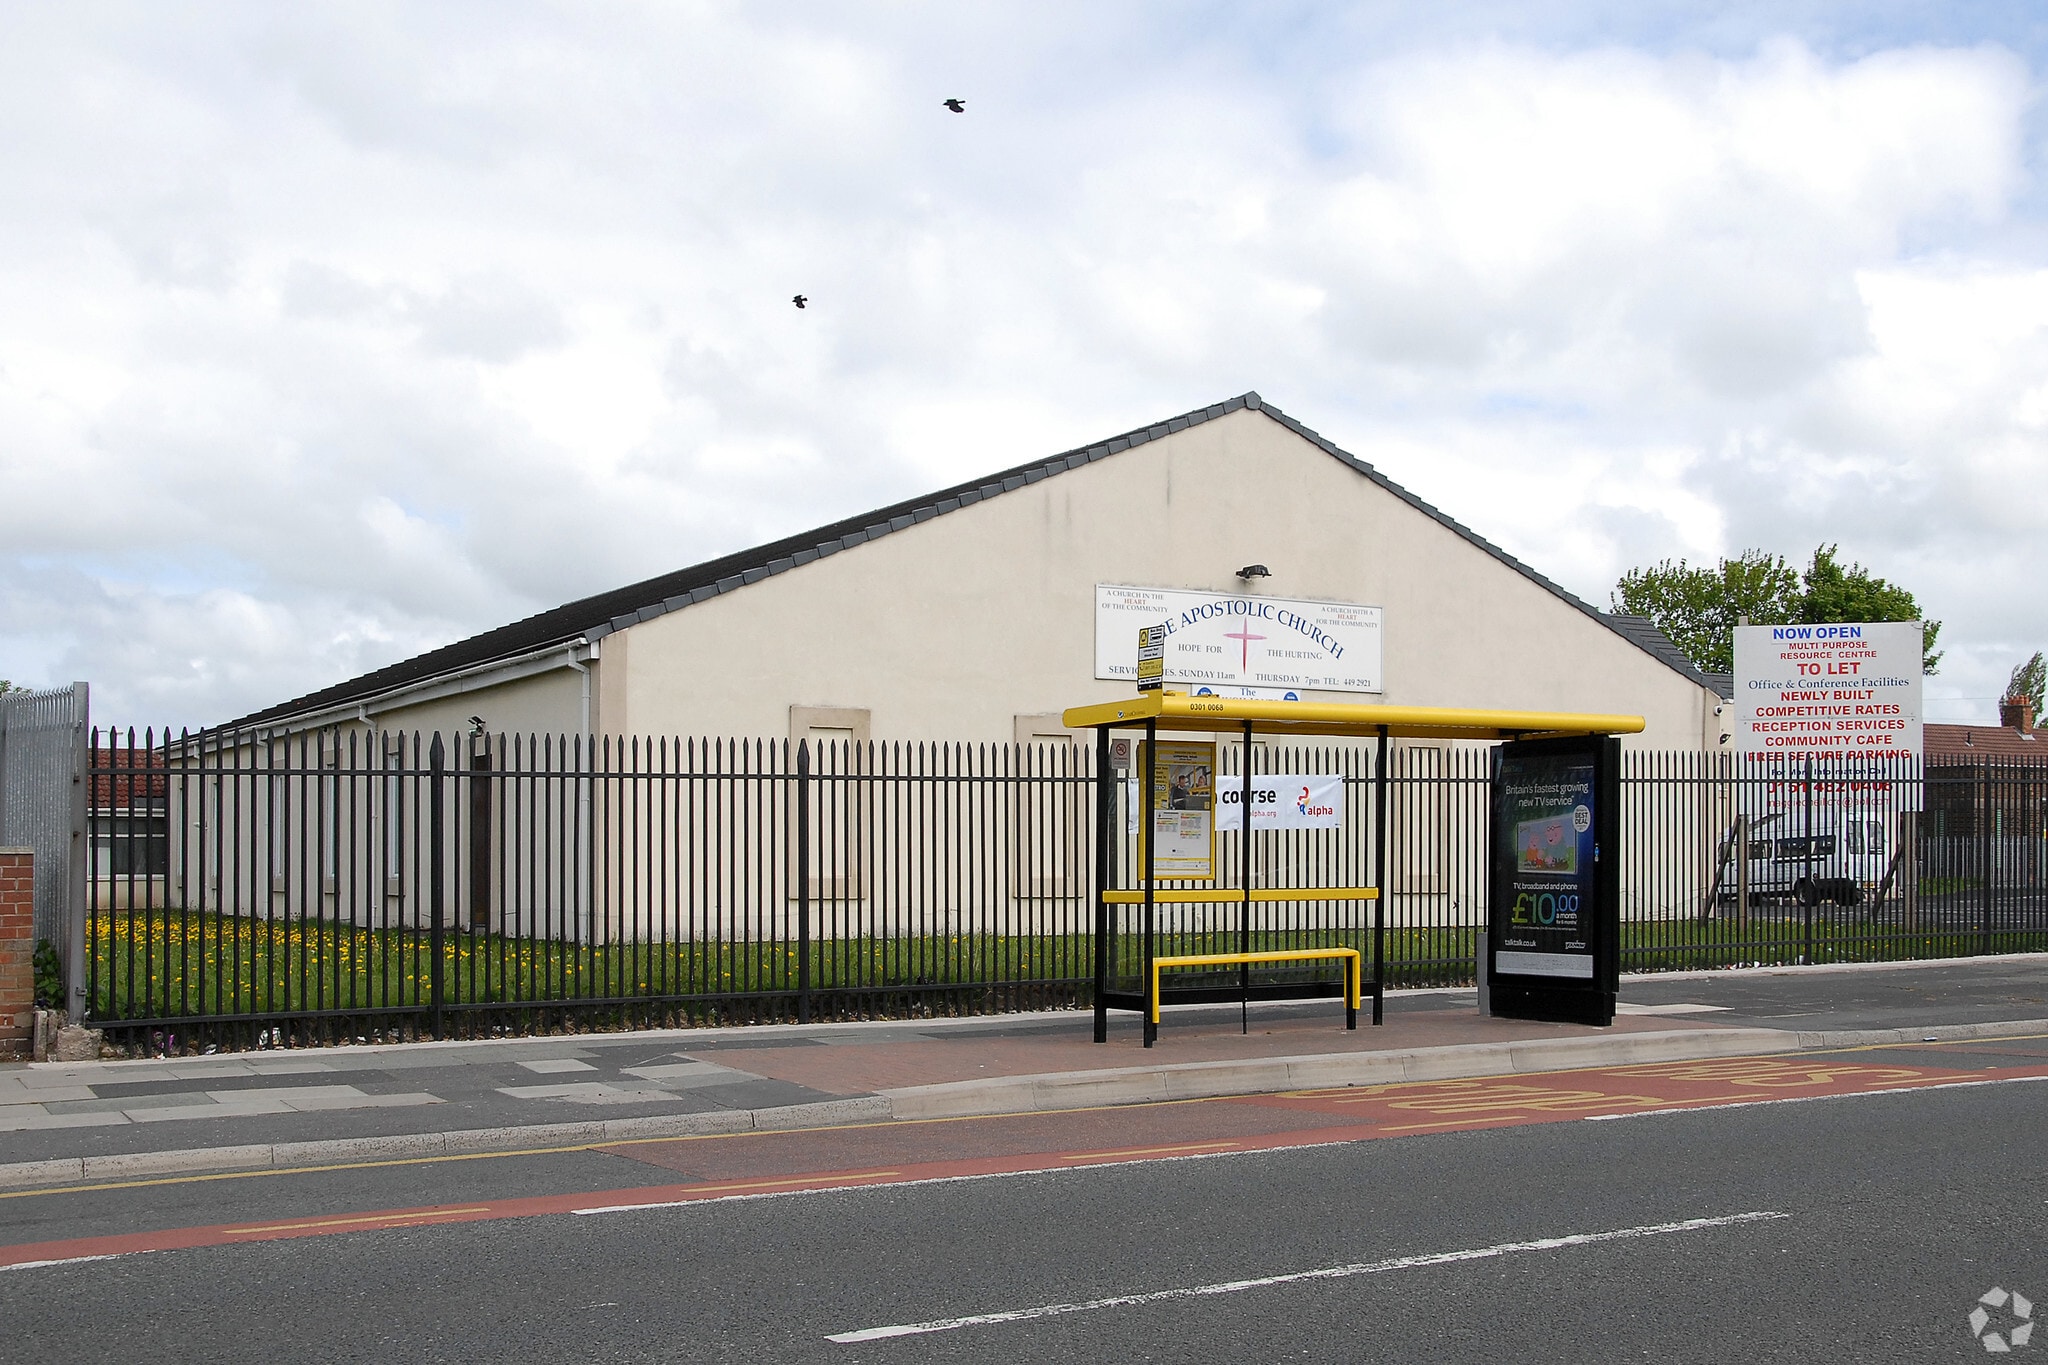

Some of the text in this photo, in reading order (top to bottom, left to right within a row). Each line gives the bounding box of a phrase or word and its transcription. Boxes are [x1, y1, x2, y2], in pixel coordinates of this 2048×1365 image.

[1126, 605, 1168, 613] COMMUNITY
[1181, 600, 1275, 628] APOSTOLIC
[1277, 609, 1345, 660] CHURCH
[1341, 620, 1378, 628] COMMUNITY
[1773, 626, 1861, 640] NOW OPEN
[1178, 643, 1222, 654] HOPE FOR
[1789, 641, 1868, 650] MULTI PURPOSE
[1267, 649, 1323, 660] THE HURTING
[1780, 650, 1877, 660] RESOURCE CENTRE
[1797, 662, 1861, 675] TO LET
[1179, 669, 1215, 679] SUNDAY
[1217, 671, 1236, 680] 11am
[1255, 673, 1300, 683] THURSDAY
[1304, 676, 1320, 686] 7pm
[1323, 677, 1339, 685] TEL:
[1748, 677, 1910, 690] Office & Conference Facilities
[1240, 688, 1256, 697] The
[1780, 690, 1874, 701] NEWLY BUILT
[1190, 703, 1206, 711] 0301
[1756, 704, 1900, 717] COMPETITIVE RATES
[1752, 719, 1905, 732] RECEPTION SERVICES
[1765, 734, 1892, 746] COMMUNITY CAFE
[1748, 749, 1911, 761] FREE SECURE PARKING
[1771, 768, 1786, 776] Fo
[1505, 781, 1588, 795] Britain's fastest growing
[1518, 799, 1533, 807] new
[1534, 796, 1545, 806] TV
[1308, 805, 1333, 817] alpha
[1513, 882, 1578, 891] TV, broadband and phone
[1511, 893, 1578, 925] £10.00
[1504, 939, 1537, 947] talktalk.co.uk
[1600, 1060, 1922, 1087] BUS
[1274, 1081, 1664, 1113] STOP
